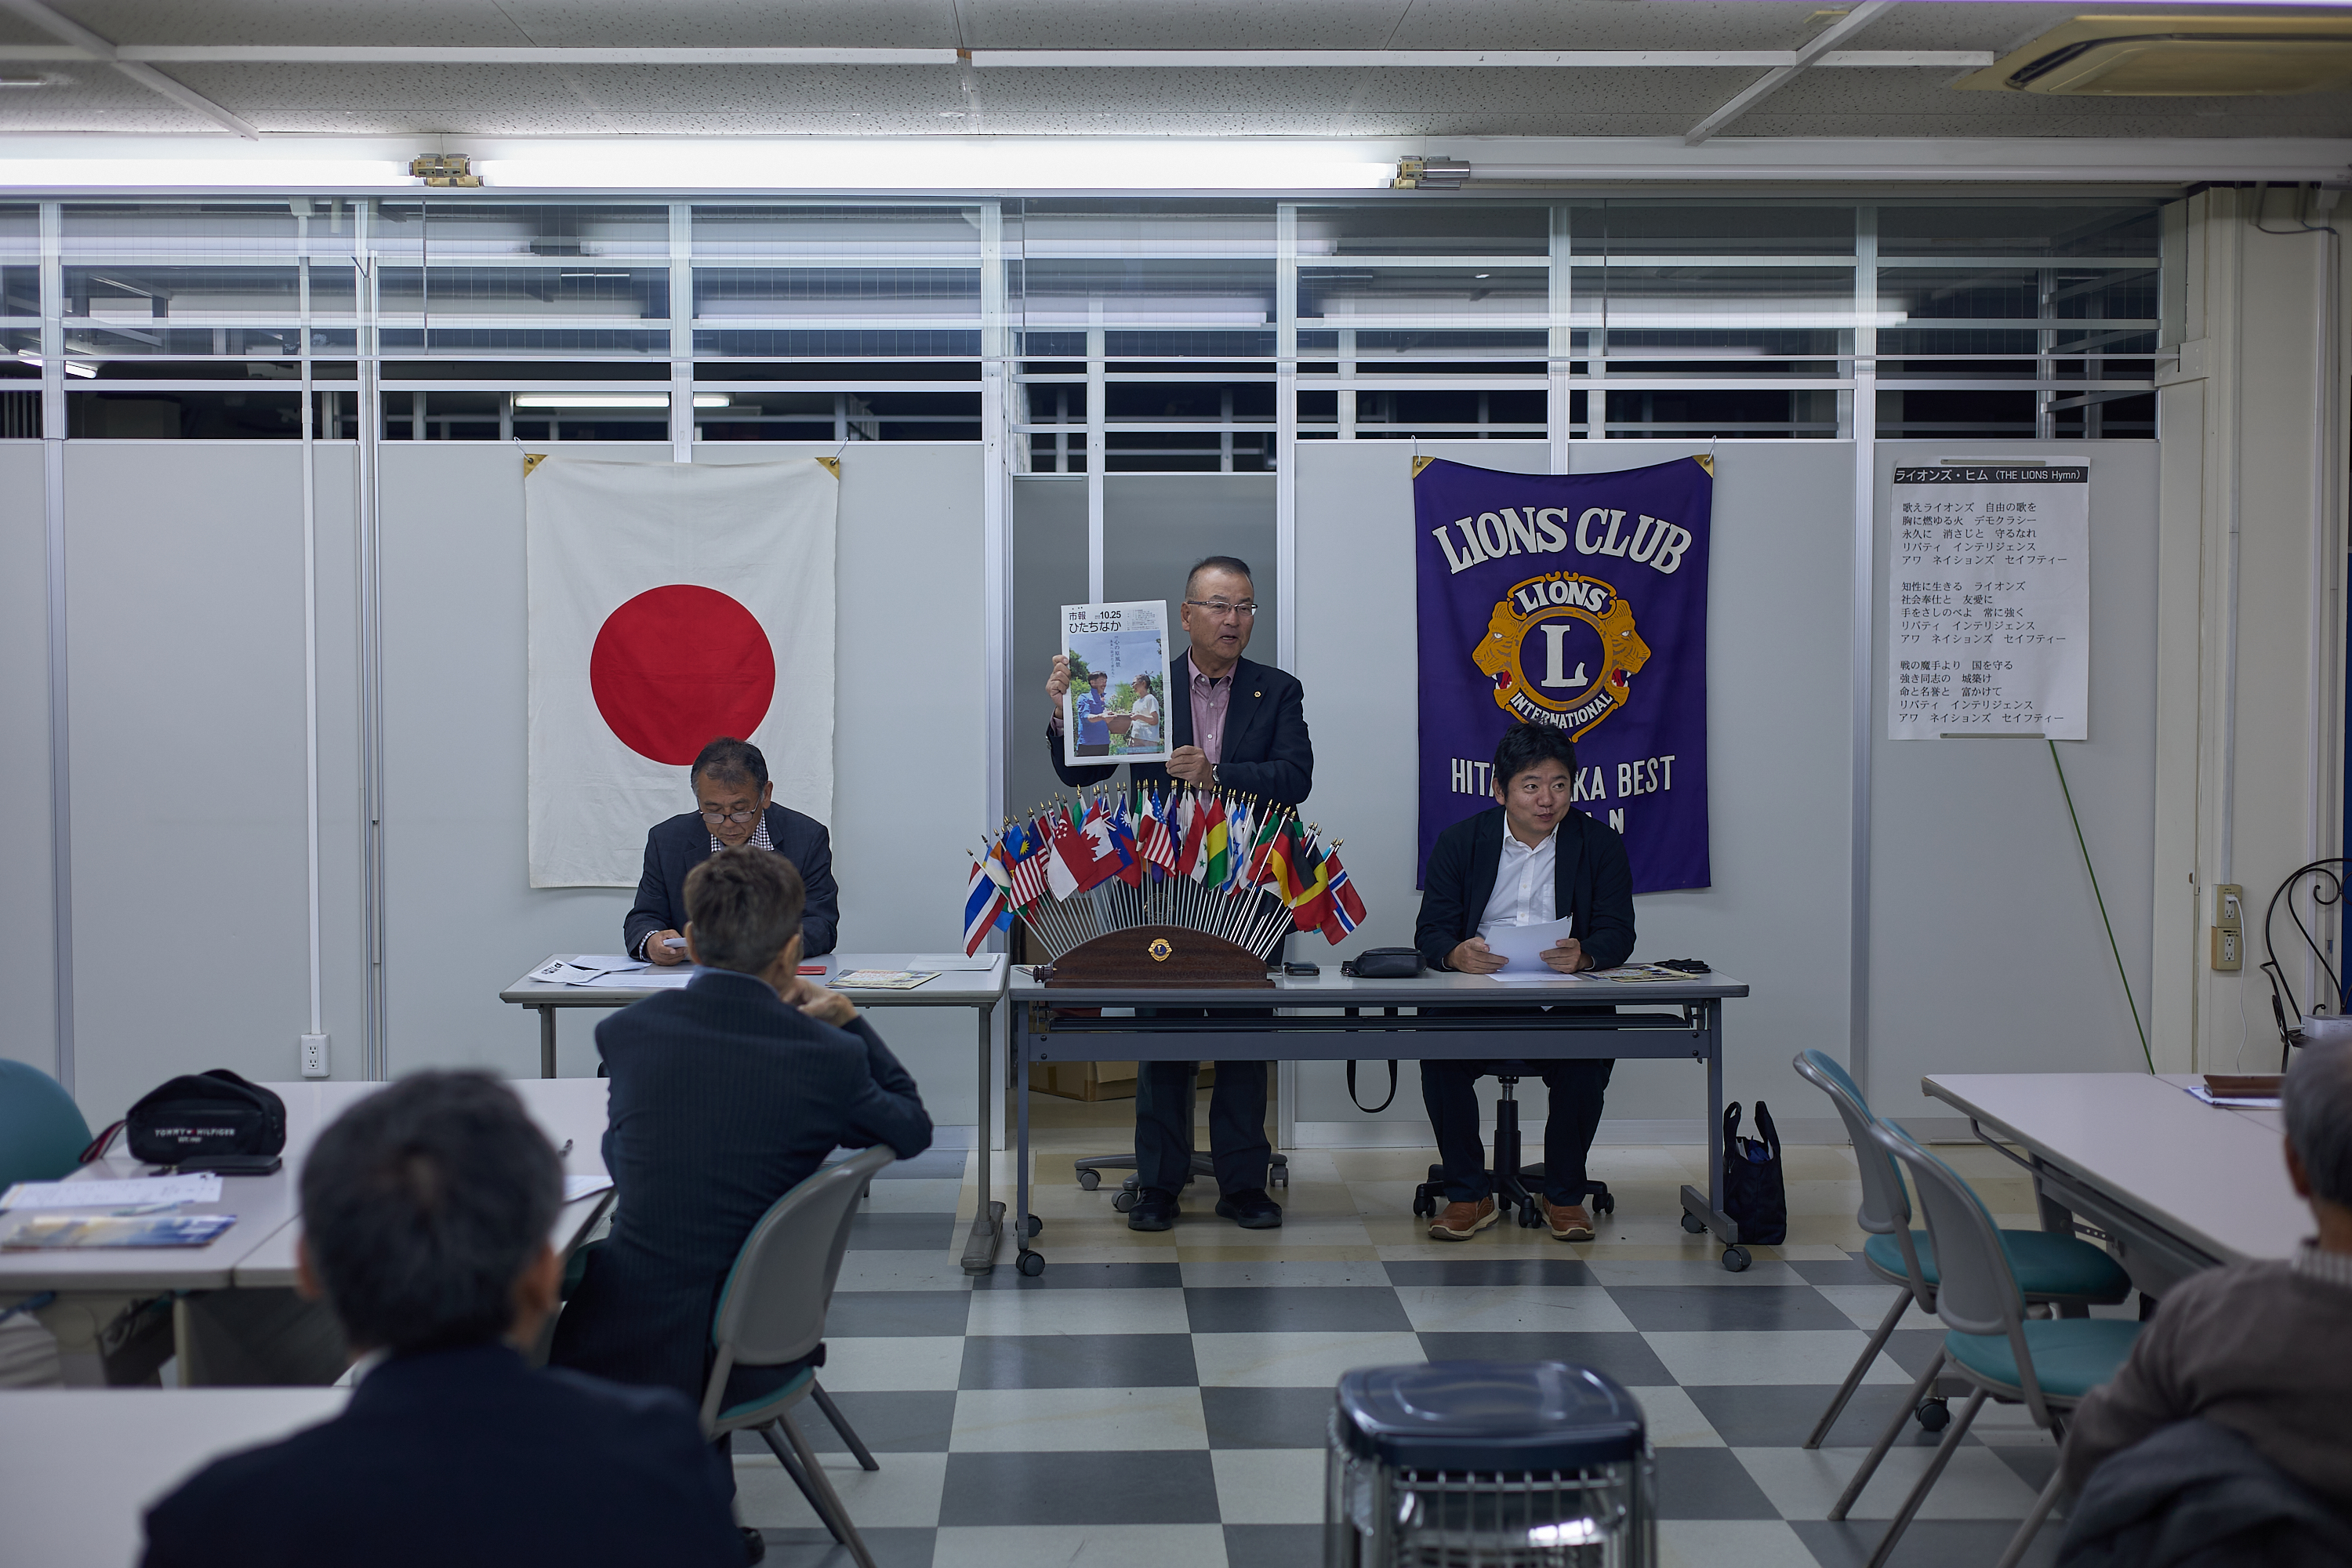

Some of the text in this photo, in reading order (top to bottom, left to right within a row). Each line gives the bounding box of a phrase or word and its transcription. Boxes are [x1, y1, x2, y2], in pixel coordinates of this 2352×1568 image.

[1896, 470, 1988, 481] ライオンズ・ヒム
[2021, 470, 2048, 480] LIONS
[1903, 502, 2036, 513] 歌えライオンズ 自由の歌を
[1903, 515, 2036, 525] 胸に燃ゆる火 デモクラシー
[1903, 528, 2036, 539] 永久に 消さじと 守るなれ
[1432, 506, 1692, 574] LIONS CLUB
[1904, 543, 2035, 552] リバティ インテリジェンス
[1903, 555, 2067, 564] アワ ネイションズ セイフティー
[1902, 581, 2025, 591] 知性に生きる ライオンズ
[1515, 581, 1609, 613] LIONS
[1901, 594, 1992, 604] 社会奉仕と 友愛に
[1069, 612, 1086, 620] 市報
[1901, 608, 2023, 617] 手をさしのべよ 常に強く
[1069, 621, 1121, 633] ひたちなか
[1903, 621, 2034, 630] リバティ インテリジェンス
[1932, 633, 1993, 644] ネイションズ
[2004, 634, 2065, 644] セイフティー
[1541, 625, 1588, 687] L
[1900, 660, 2013, 670] 戦の魔手より 国を守る
[1900, 673, 1991, 684] 強き同志の 城築け
[1900, 687, 2002, 697] 命と名誉と 富かけて
[1901, 700, 2032, 710] リバティ インテリジェンス
[1510, 692, 1613, 729] INTERNATIONAL
[1900, 713, 2063, 723] アワ ネイションズ セイフティー
[1617, 755, 1675, 798] BEST
[155, 1127, 235, 1137] TOMMY HILFIGER
